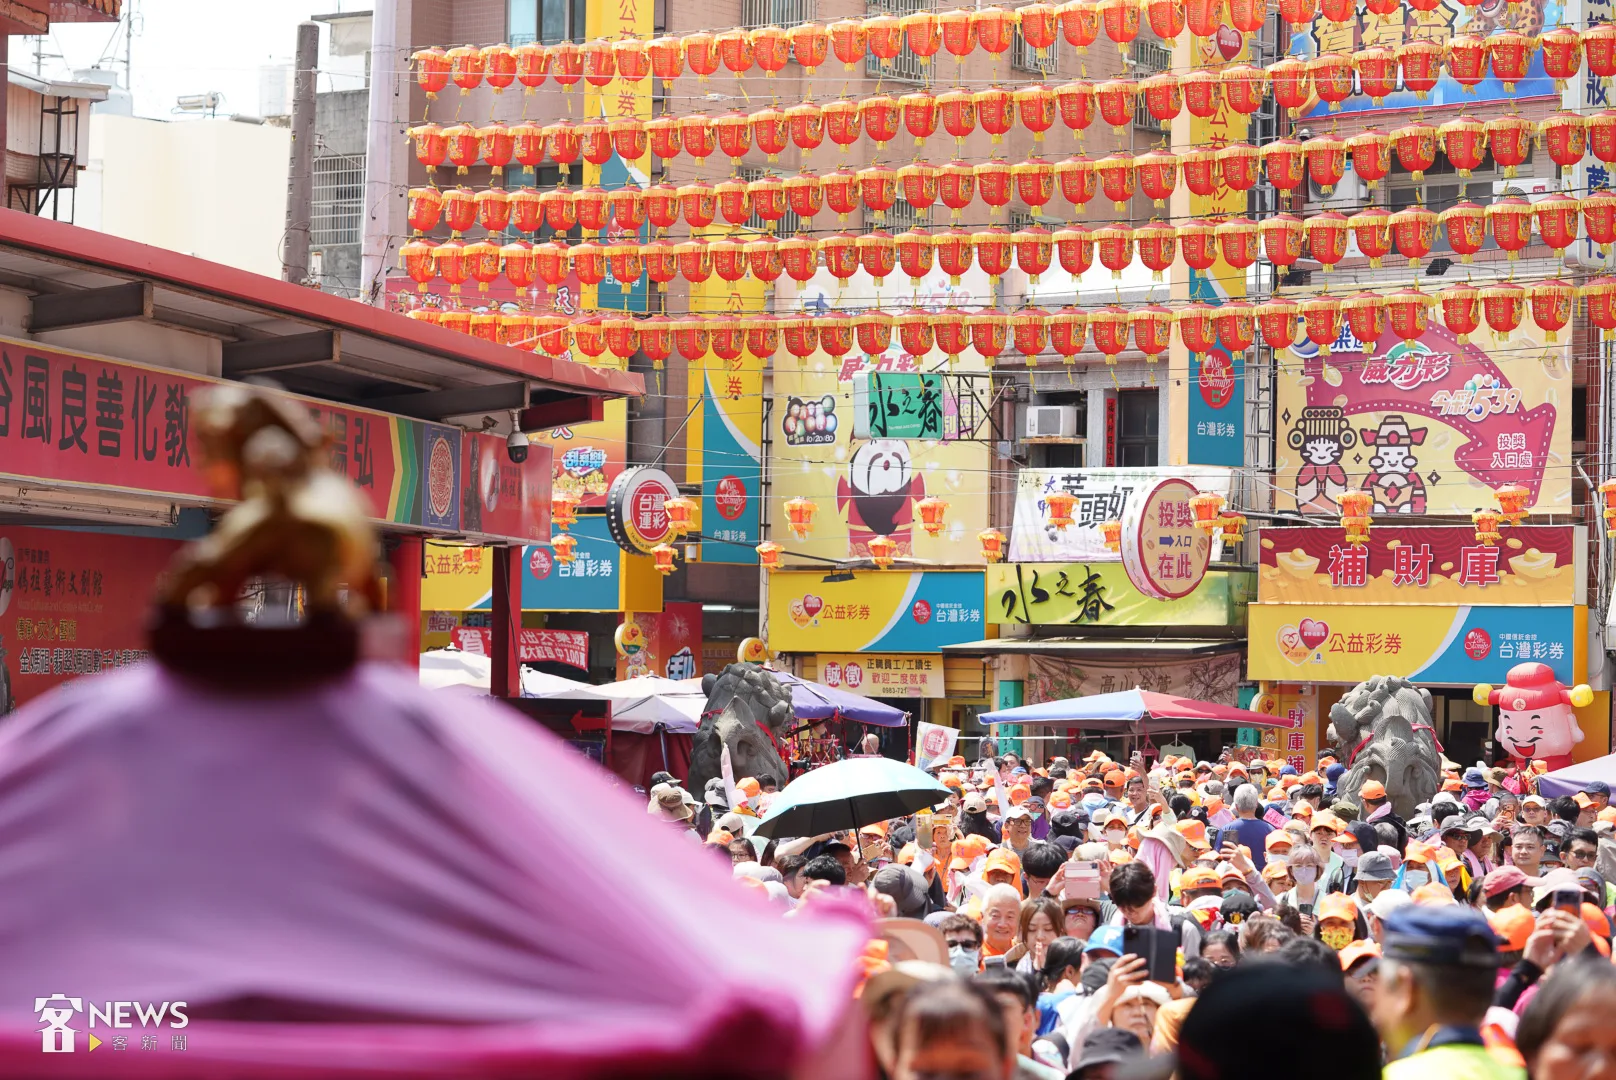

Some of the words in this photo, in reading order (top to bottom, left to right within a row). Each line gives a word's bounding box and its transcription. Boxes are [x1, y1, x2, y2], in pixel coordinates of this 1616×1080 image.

[1361, 352, 1451, 389] 威力彩
[1430, 387, 1522, 422] 今彩539
[1197, 421, 1235, 437] 台灣彩券
[1498, 433, 1525, 450] 投獎
[1490, 452, 1532, 468] 入口處
[639, 493, 665, 511] 台灣
[639, 511, 665, 529] 運彩
[1158, 501, 1193, 528] 投獎
[714, 530, 746, 541] 台灣彩券
[1175, 535, 1192, 547] 入口
[558, 558, 613, 577] 台灣彩券
[1158, 553, 1192, 579] 在此
[1329, 544, 1500, 586] 補財庫
[1002, 564, 1115, 624] 水之春
[822, 604, 870, 620] 公益彩券
[936, 609, 981, 623] 台灣彩券
[1329, 632, 1402, 654] 公益彩券
[1499, 642, 1564, 660] 台灣彩券
[825, 664, 862, 686] 誠徵
[872, 672, 928, 686] 歡迎二度就業
